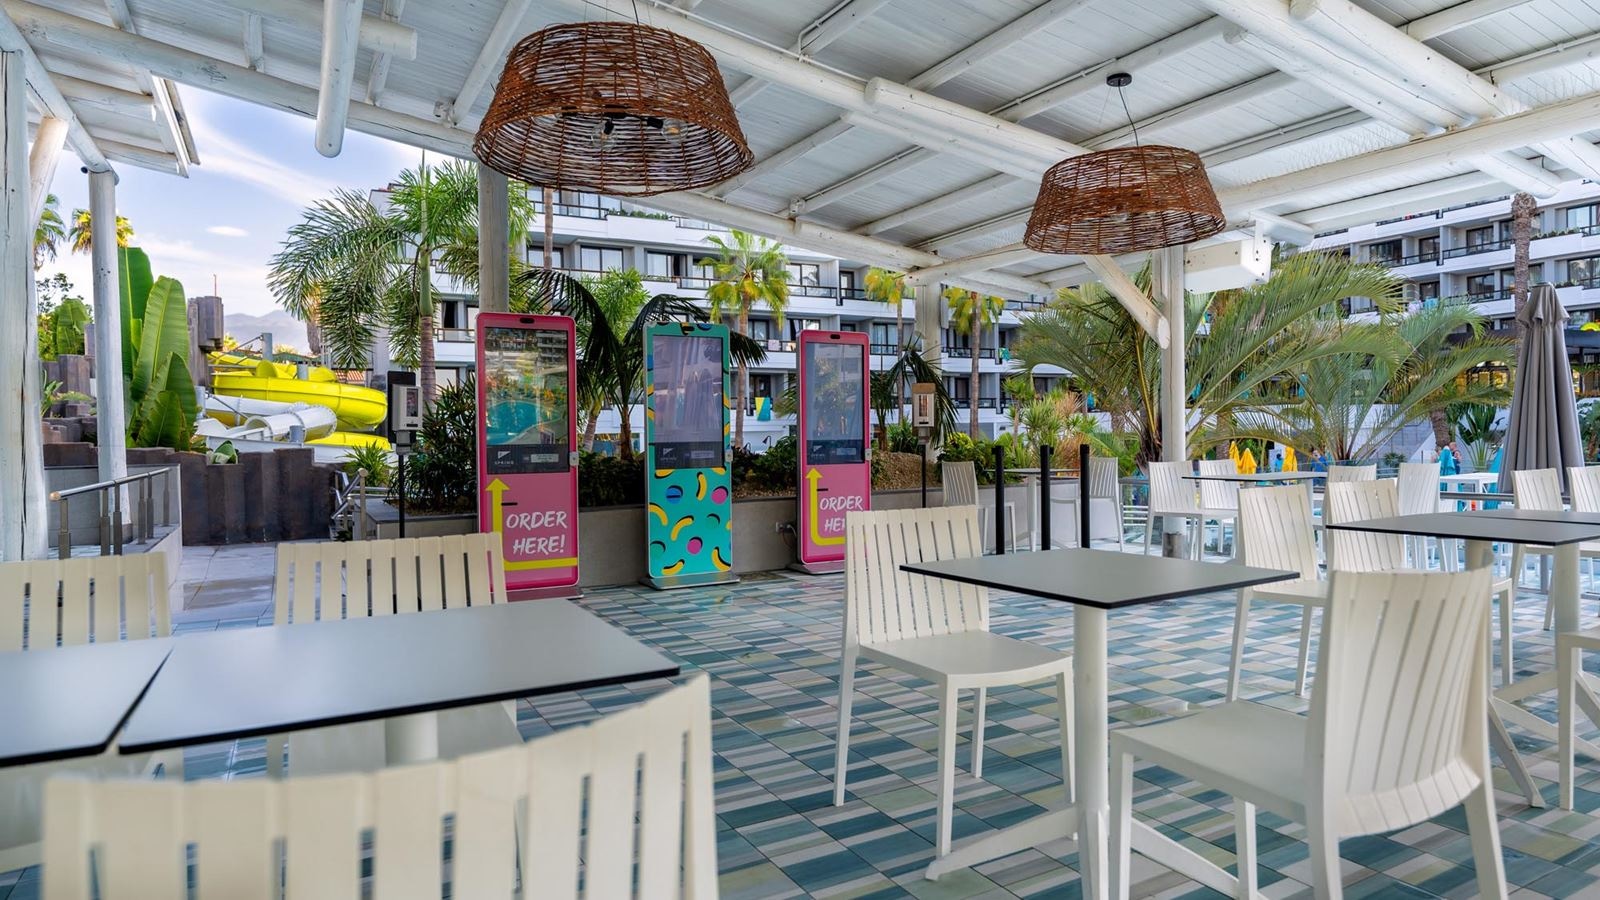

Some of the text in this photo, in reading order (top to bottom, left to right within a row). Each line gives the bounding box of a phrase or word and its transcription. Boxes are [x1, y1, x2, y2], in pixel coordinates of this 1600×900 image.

[820, 495, 863, 512] ORDER
[506, 511, 567, 531] ORDER
[513, 534, 566, 555] HERE!
